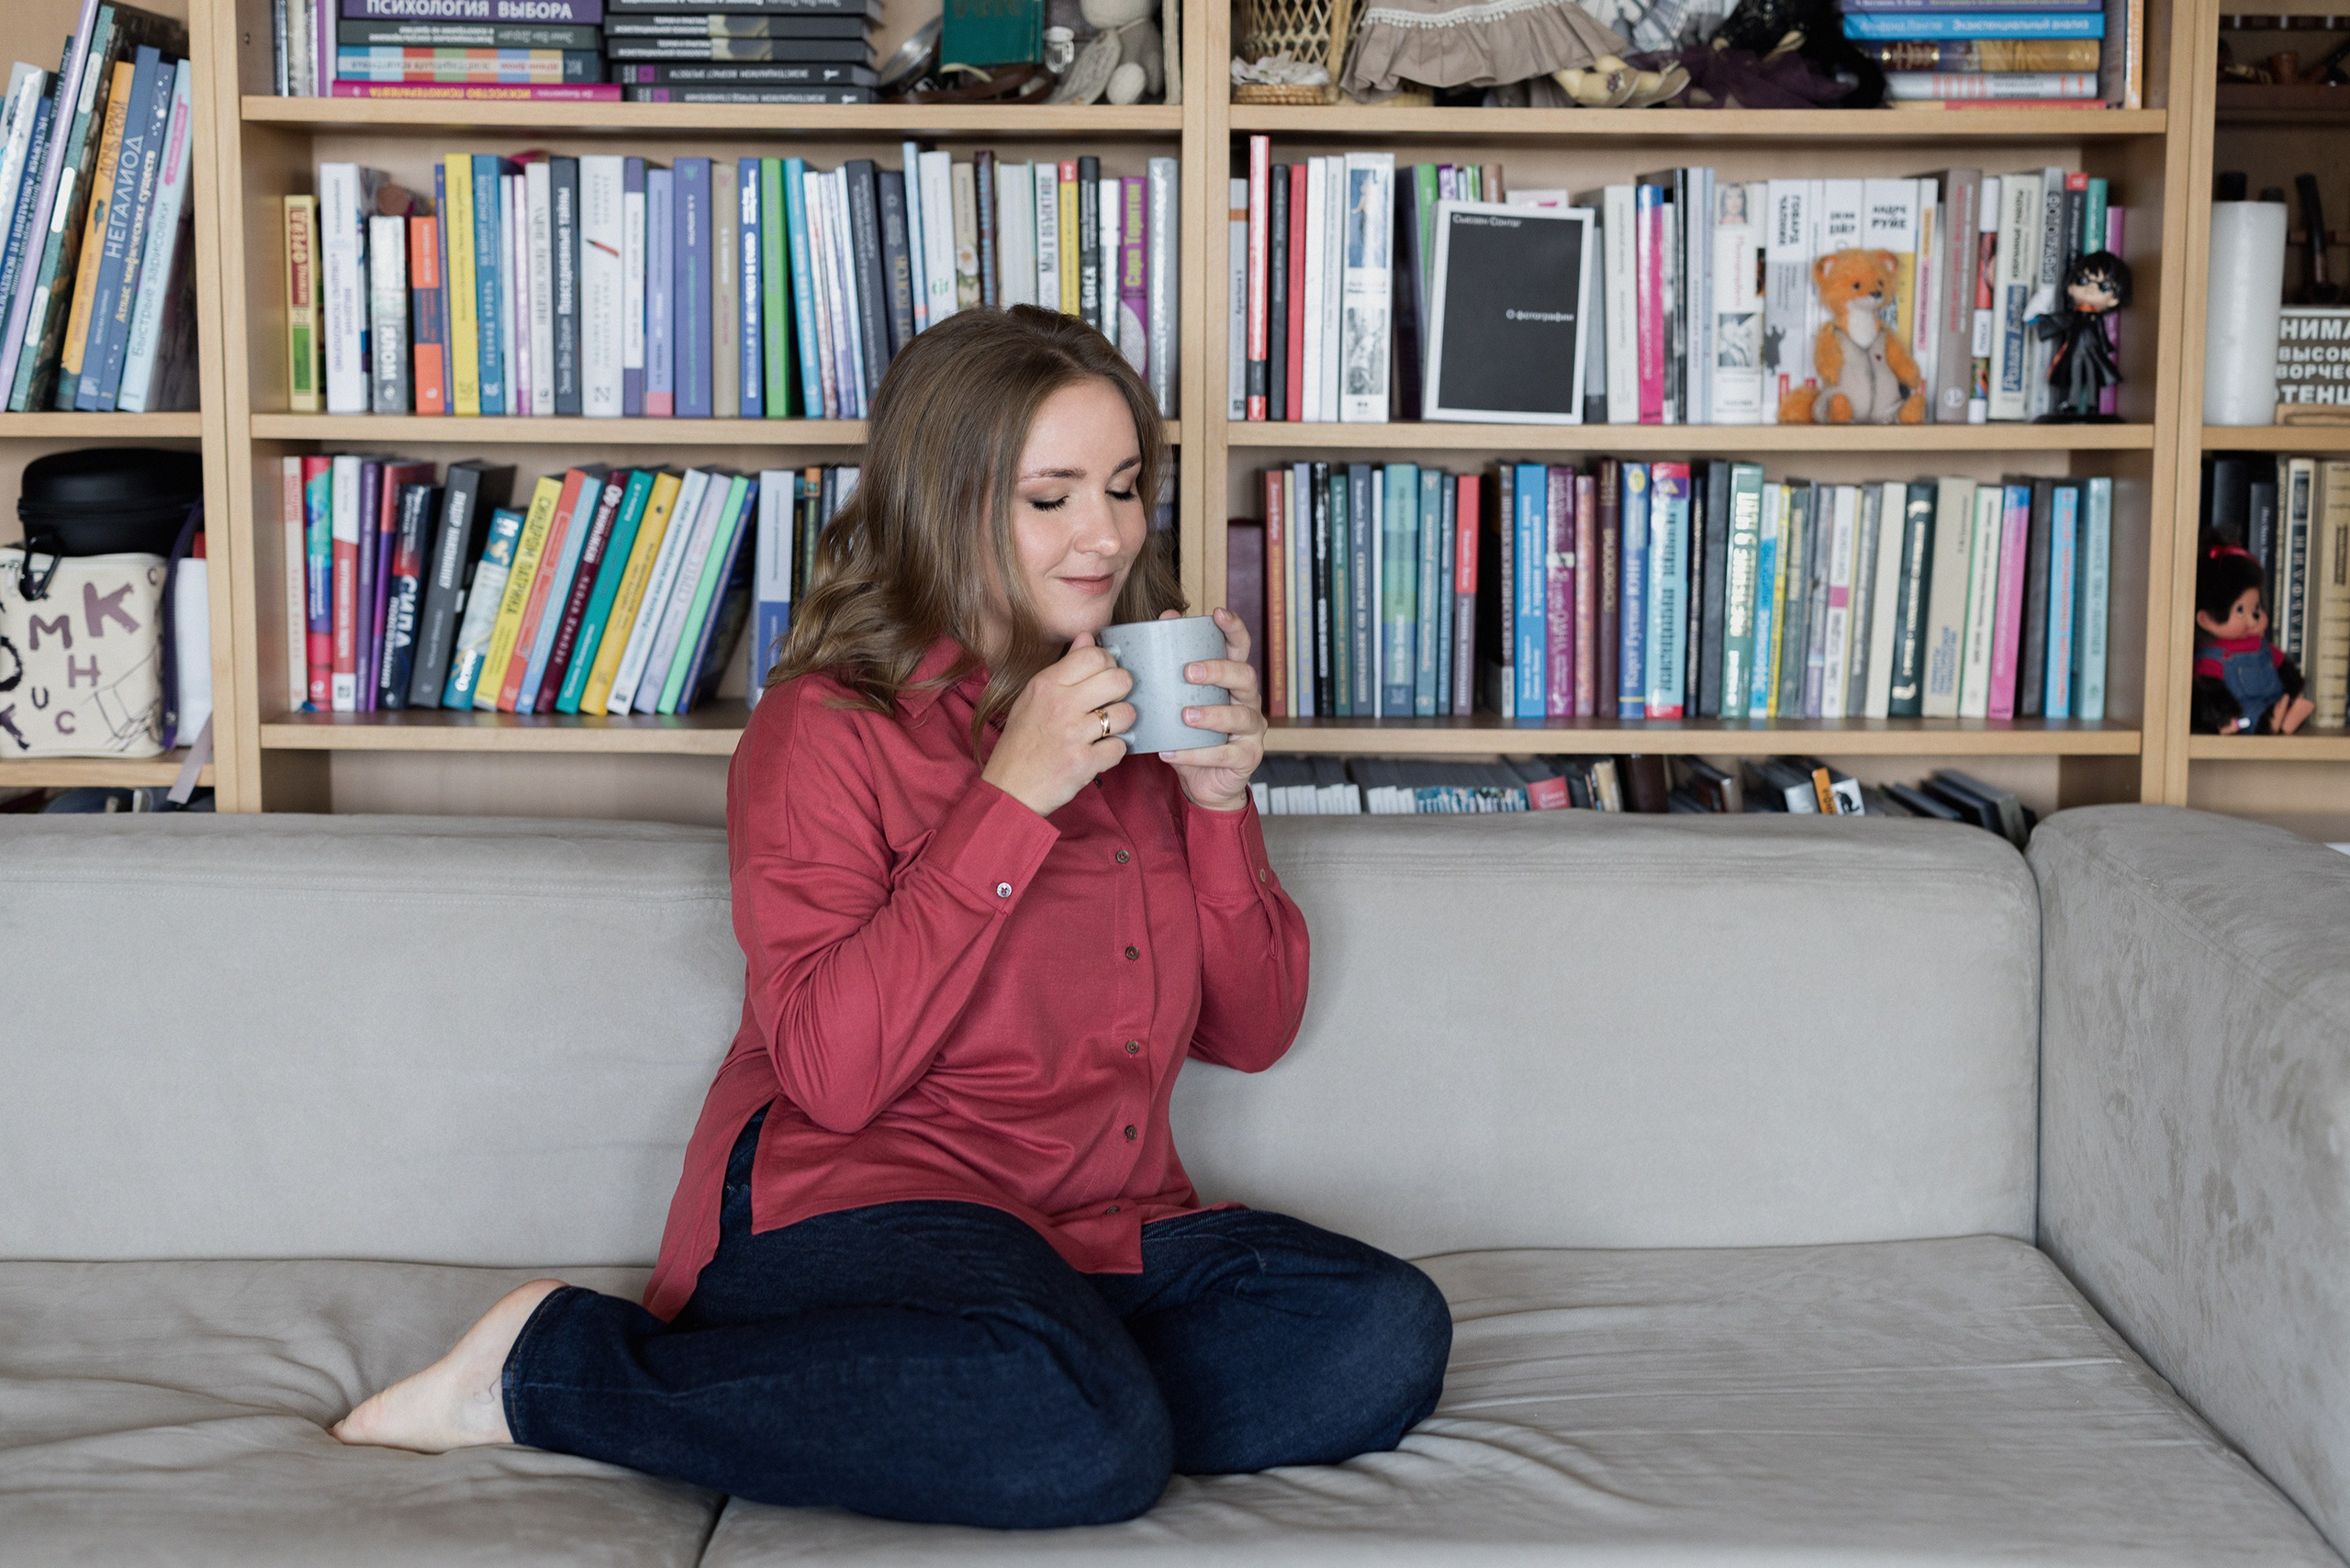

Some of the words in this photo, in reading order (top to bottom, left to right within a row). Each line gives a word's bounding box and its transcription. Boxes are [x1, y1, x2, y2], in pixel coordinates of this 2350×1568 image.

[366, 0, 490, 18] ПСИХОЛОГИЯ
[498, 1, 574, 20] ВЫБОРА
[103, 131, 144, 260] НЕГАЛИОД
[137, 148, 160, 204] существ
[554, 186, 569, 227] тайны
[1124, 184, 1144, 246] Торнтон
[1789, 194, 1800, 244] ГОВАРД
[121, 204, 150, 286] мифических
[1125, 249, 1144, 286] Сара
[555, 227, 573, 316] Повседневные
[113, 286, 132, 324] Атлас
[130, 286, 157, 359] Быстрые
[1505, 308, 1516, 320] О
[1516, 309, 1574, 322] фотографии
[447, 488, 466, 528] ЛИДЕР
[437, 526, 460, 590] НАИЗНАНКУ
[1355, 551, 1366, 609] СЕМИНАРЫ
[1626, 555, 1640, 597] ЮНГ
[29, 614, 73, 650] M
[84, 582, 140, 637] K
[394, 575, 417, 648] СИЛА
[1357, 610, 1366, 628] ПО
[1625, 599, 1641, 646] Густав
[1624, 651, 1640, 688] Карл
